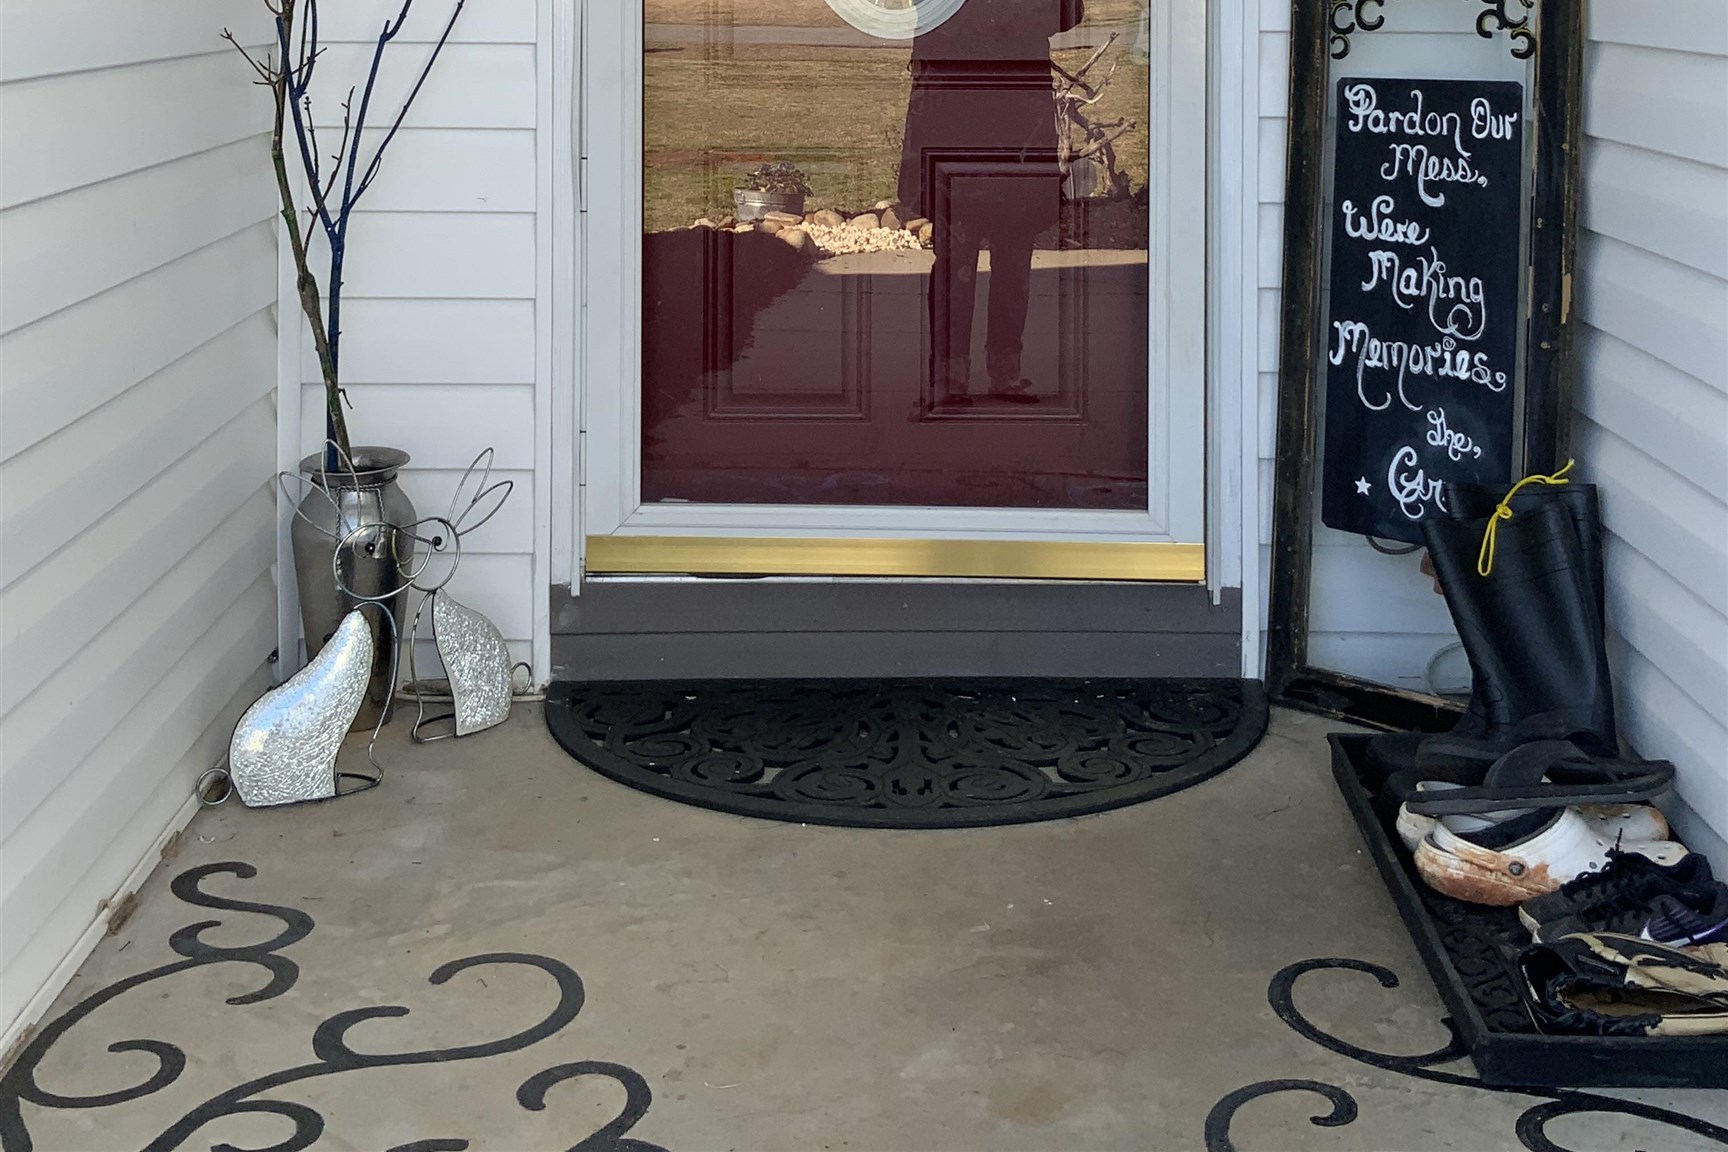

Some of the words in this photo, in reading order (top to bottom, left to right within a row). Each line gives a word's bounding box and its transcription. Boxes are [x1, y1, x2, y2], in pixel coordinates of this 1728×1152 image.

[1344, 83, 1472, 160] Pardon
[1470, 97, 1518, 141] Our
[1341, 194, 1430, 246] Were
[1361, 245, 1486, 341] Making
